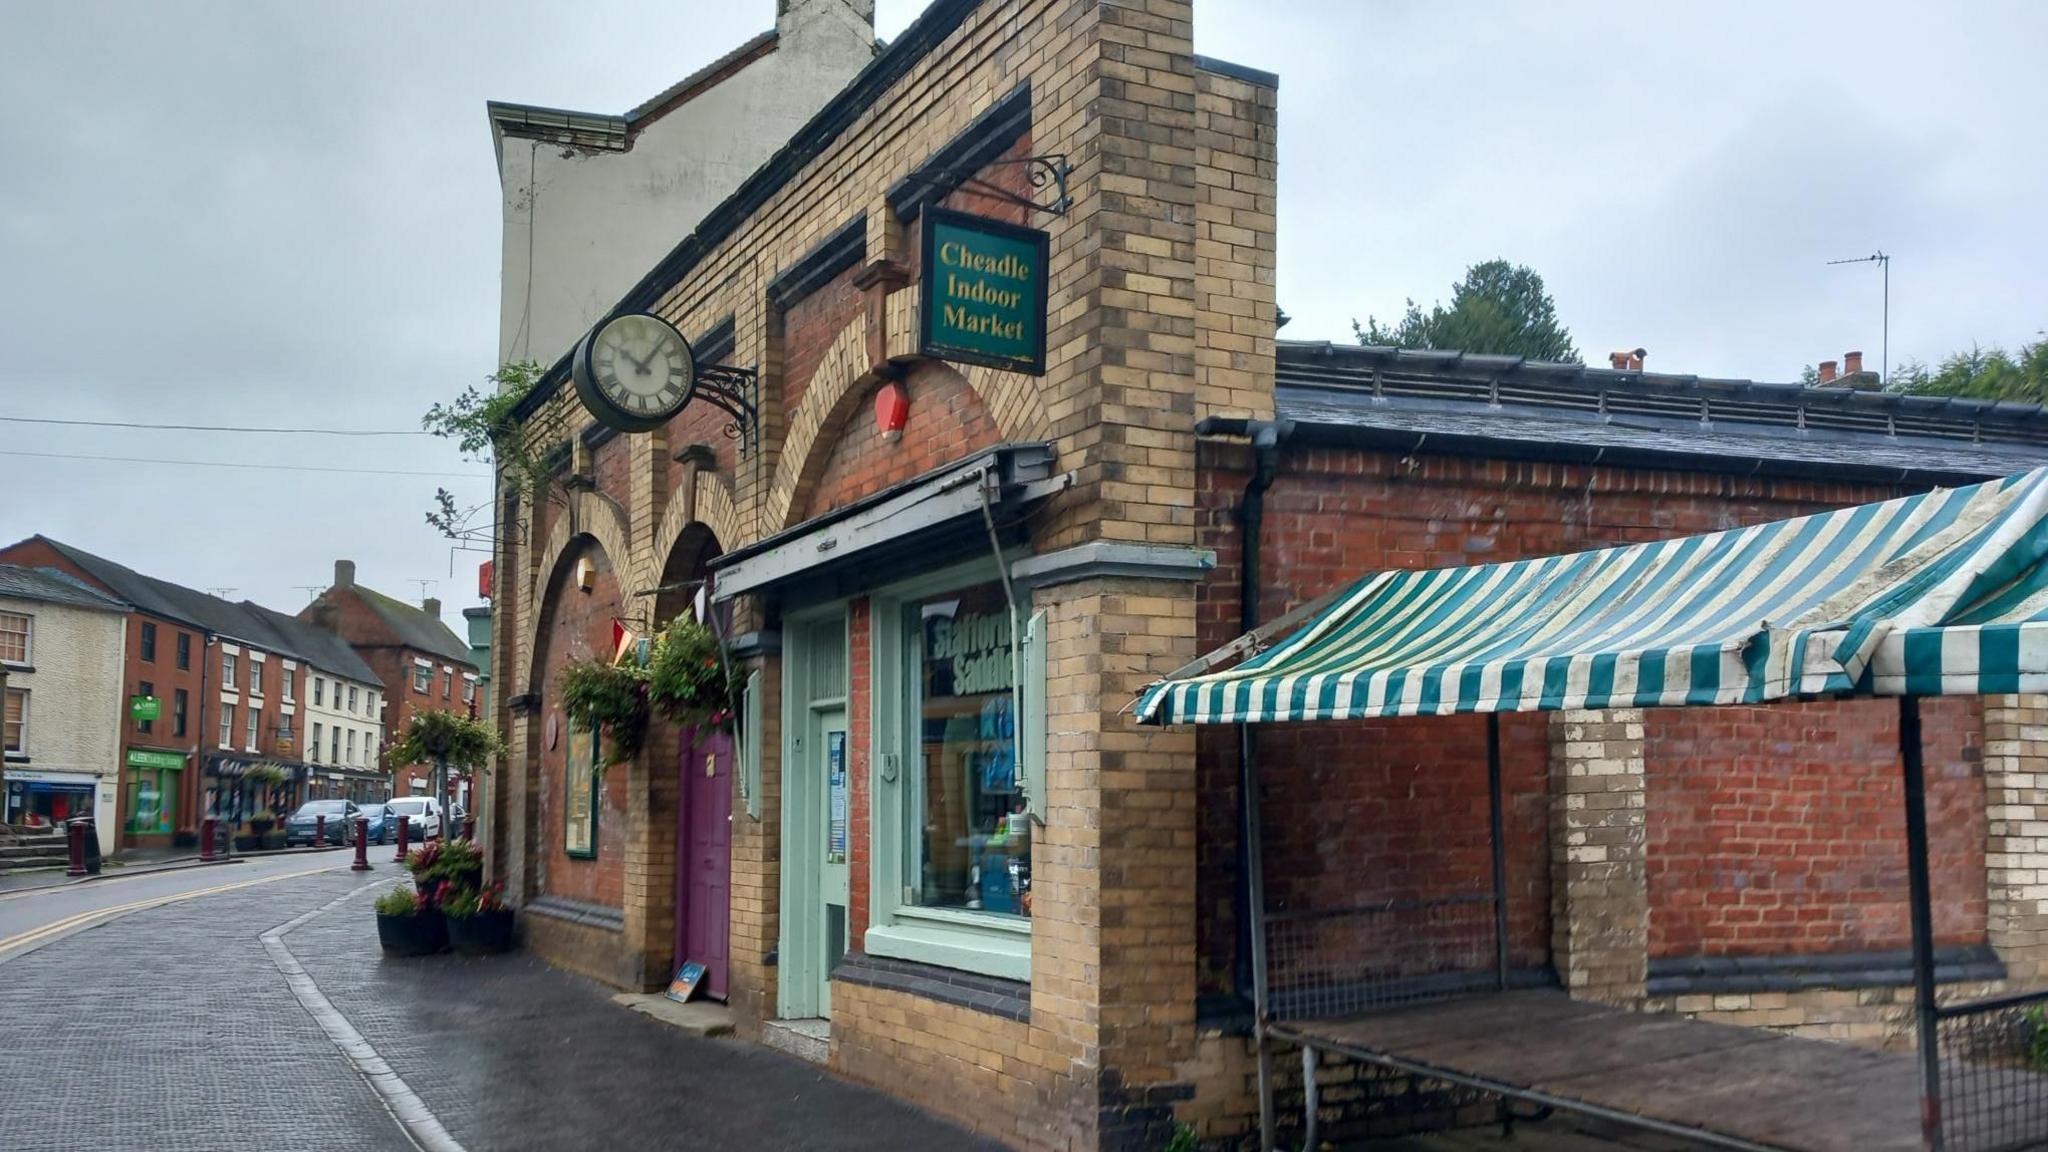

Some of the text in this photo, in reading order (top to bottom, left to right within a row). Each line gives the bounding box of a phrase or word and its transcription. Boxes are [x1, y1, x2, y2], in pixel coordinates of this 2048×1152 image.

[940, 241, 1029, 281] Cheadle
[947, 272, 1021, 309] Indoor
[943, 302, 1024, 341] Market
